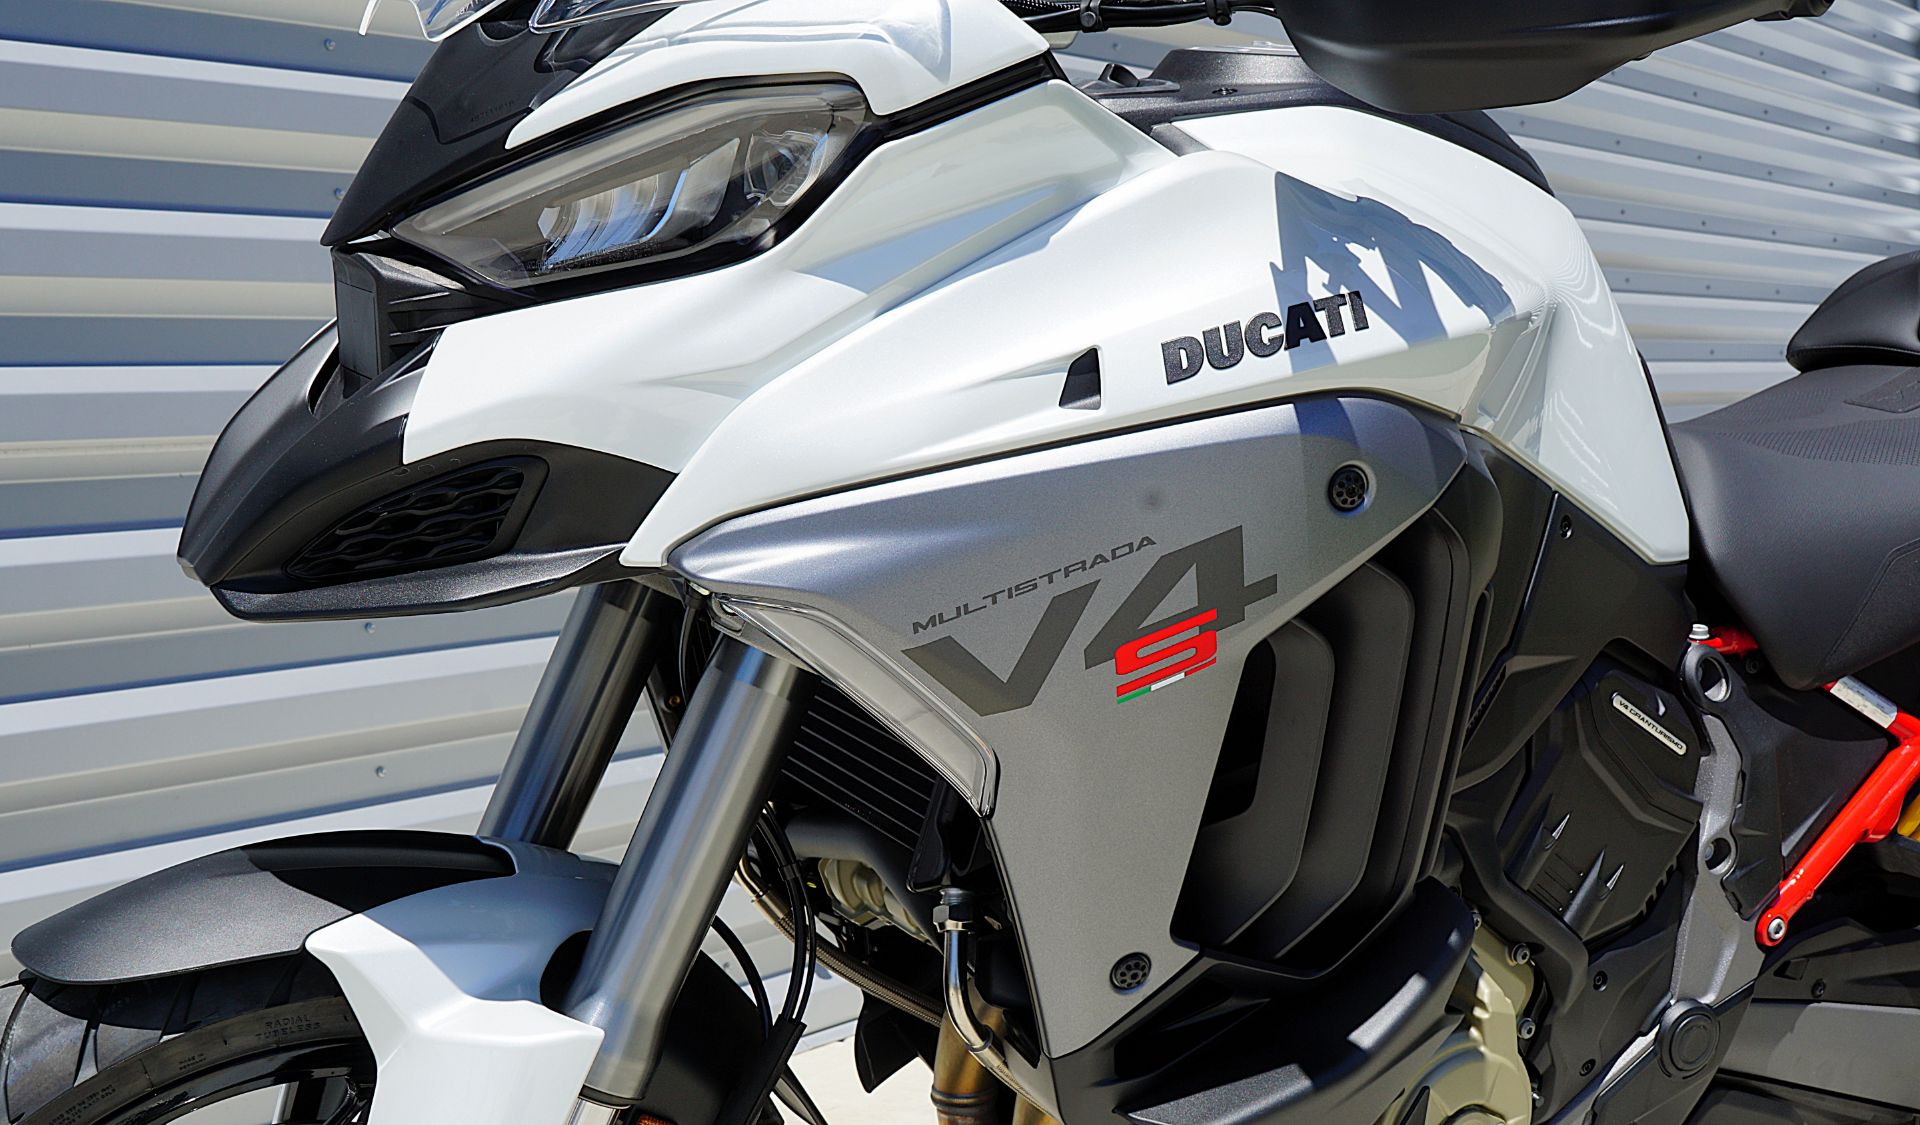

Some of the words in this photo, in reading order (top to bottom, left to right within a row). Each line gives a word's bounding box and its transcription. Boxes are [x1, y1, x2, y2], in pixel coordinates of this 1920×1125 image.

[1160, 290, 1370, 385] DUCATI
[900, 525, 1278, 717] V4
[1114, 607, 1218, 698] S
[911, 535, 1157, 635] MULTISTRADA
[1619, 700, 1629, 710] V4
[1629, 708, 1683, 750] GRANTURISMO
[264, 1014, 312, 1029] RADIAL
